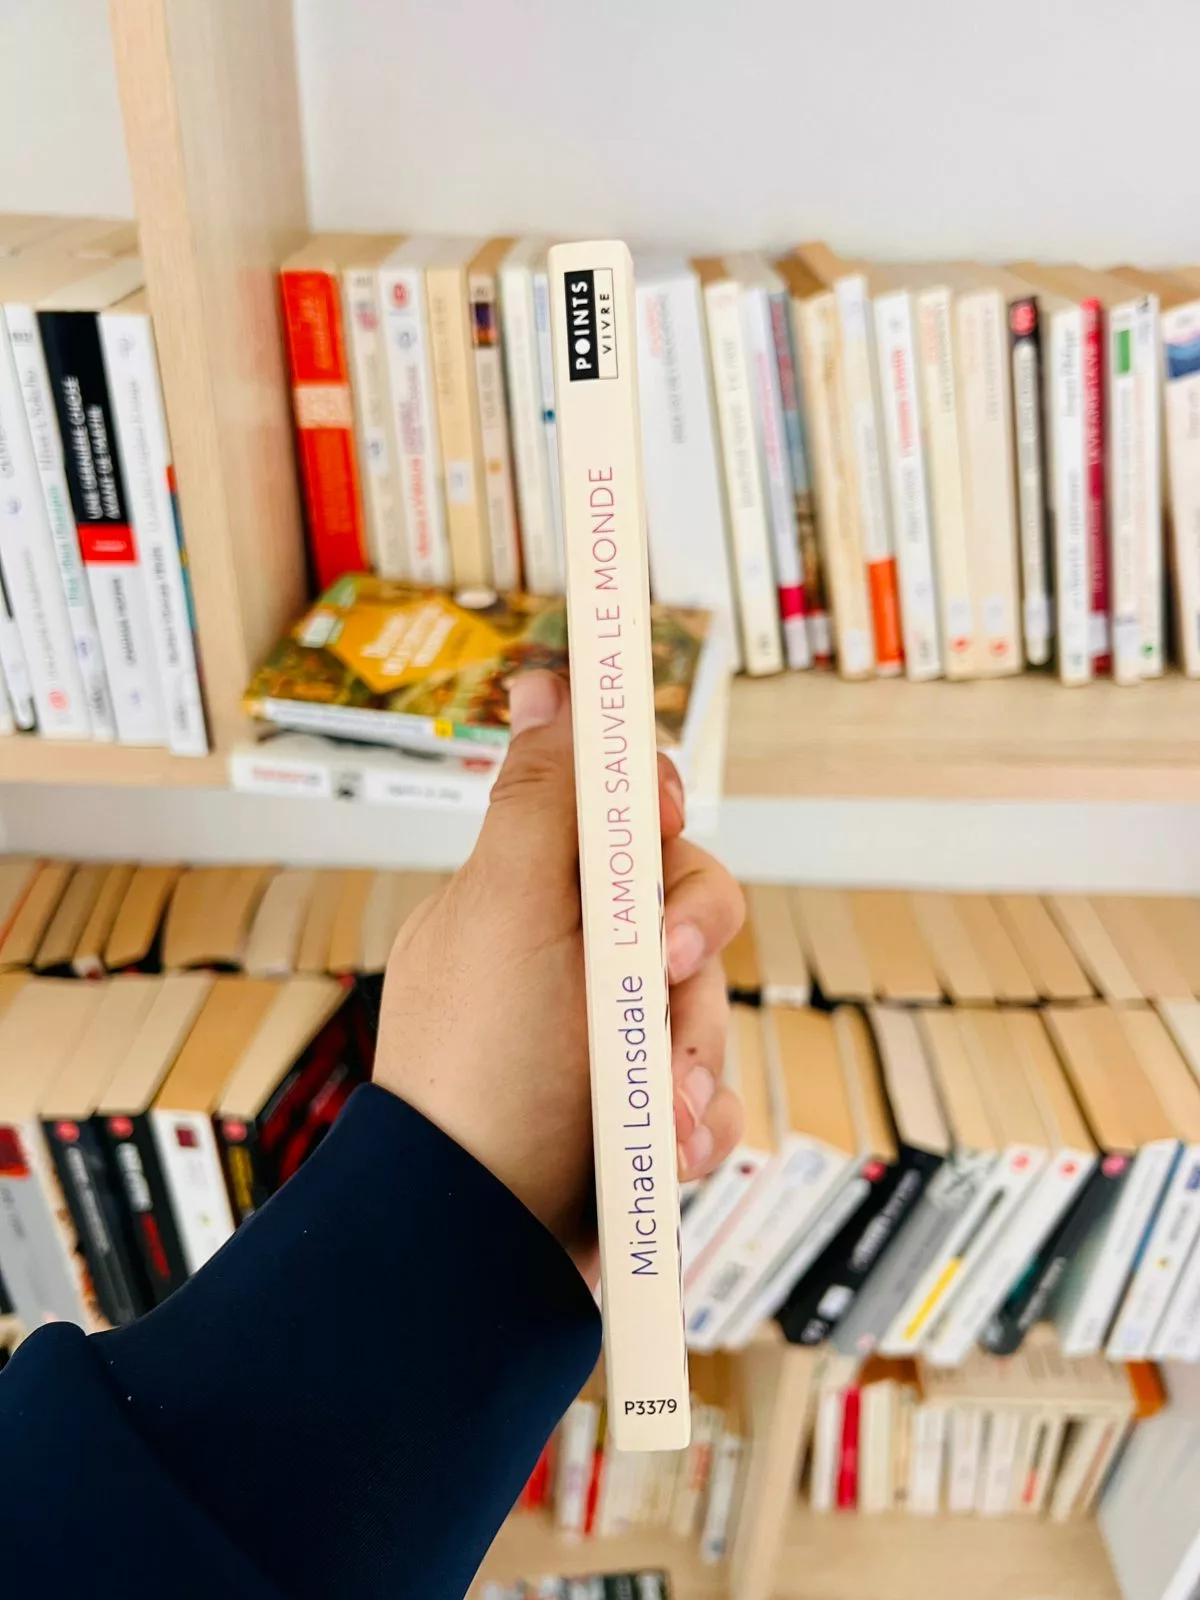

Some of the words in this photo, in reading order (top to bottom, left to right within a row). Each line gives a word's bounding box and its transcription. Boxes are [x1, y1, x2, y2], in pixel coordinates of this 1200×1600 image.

[570, 280, 593, 371] POINTS
[599, 293, 613, 355] VIVRE
[588, 466, 619, 591] MONDE
[596, 604, 621, 638] LE
[599, 652, 630, 794] SAUVERA
[607, 806, 638, 946] L'AMOUR
[616, 975, 651, 1129] Lonsdale
[624, 1144, 659, 1276] Michael
[624, 1398, 678, 1416] P3379
